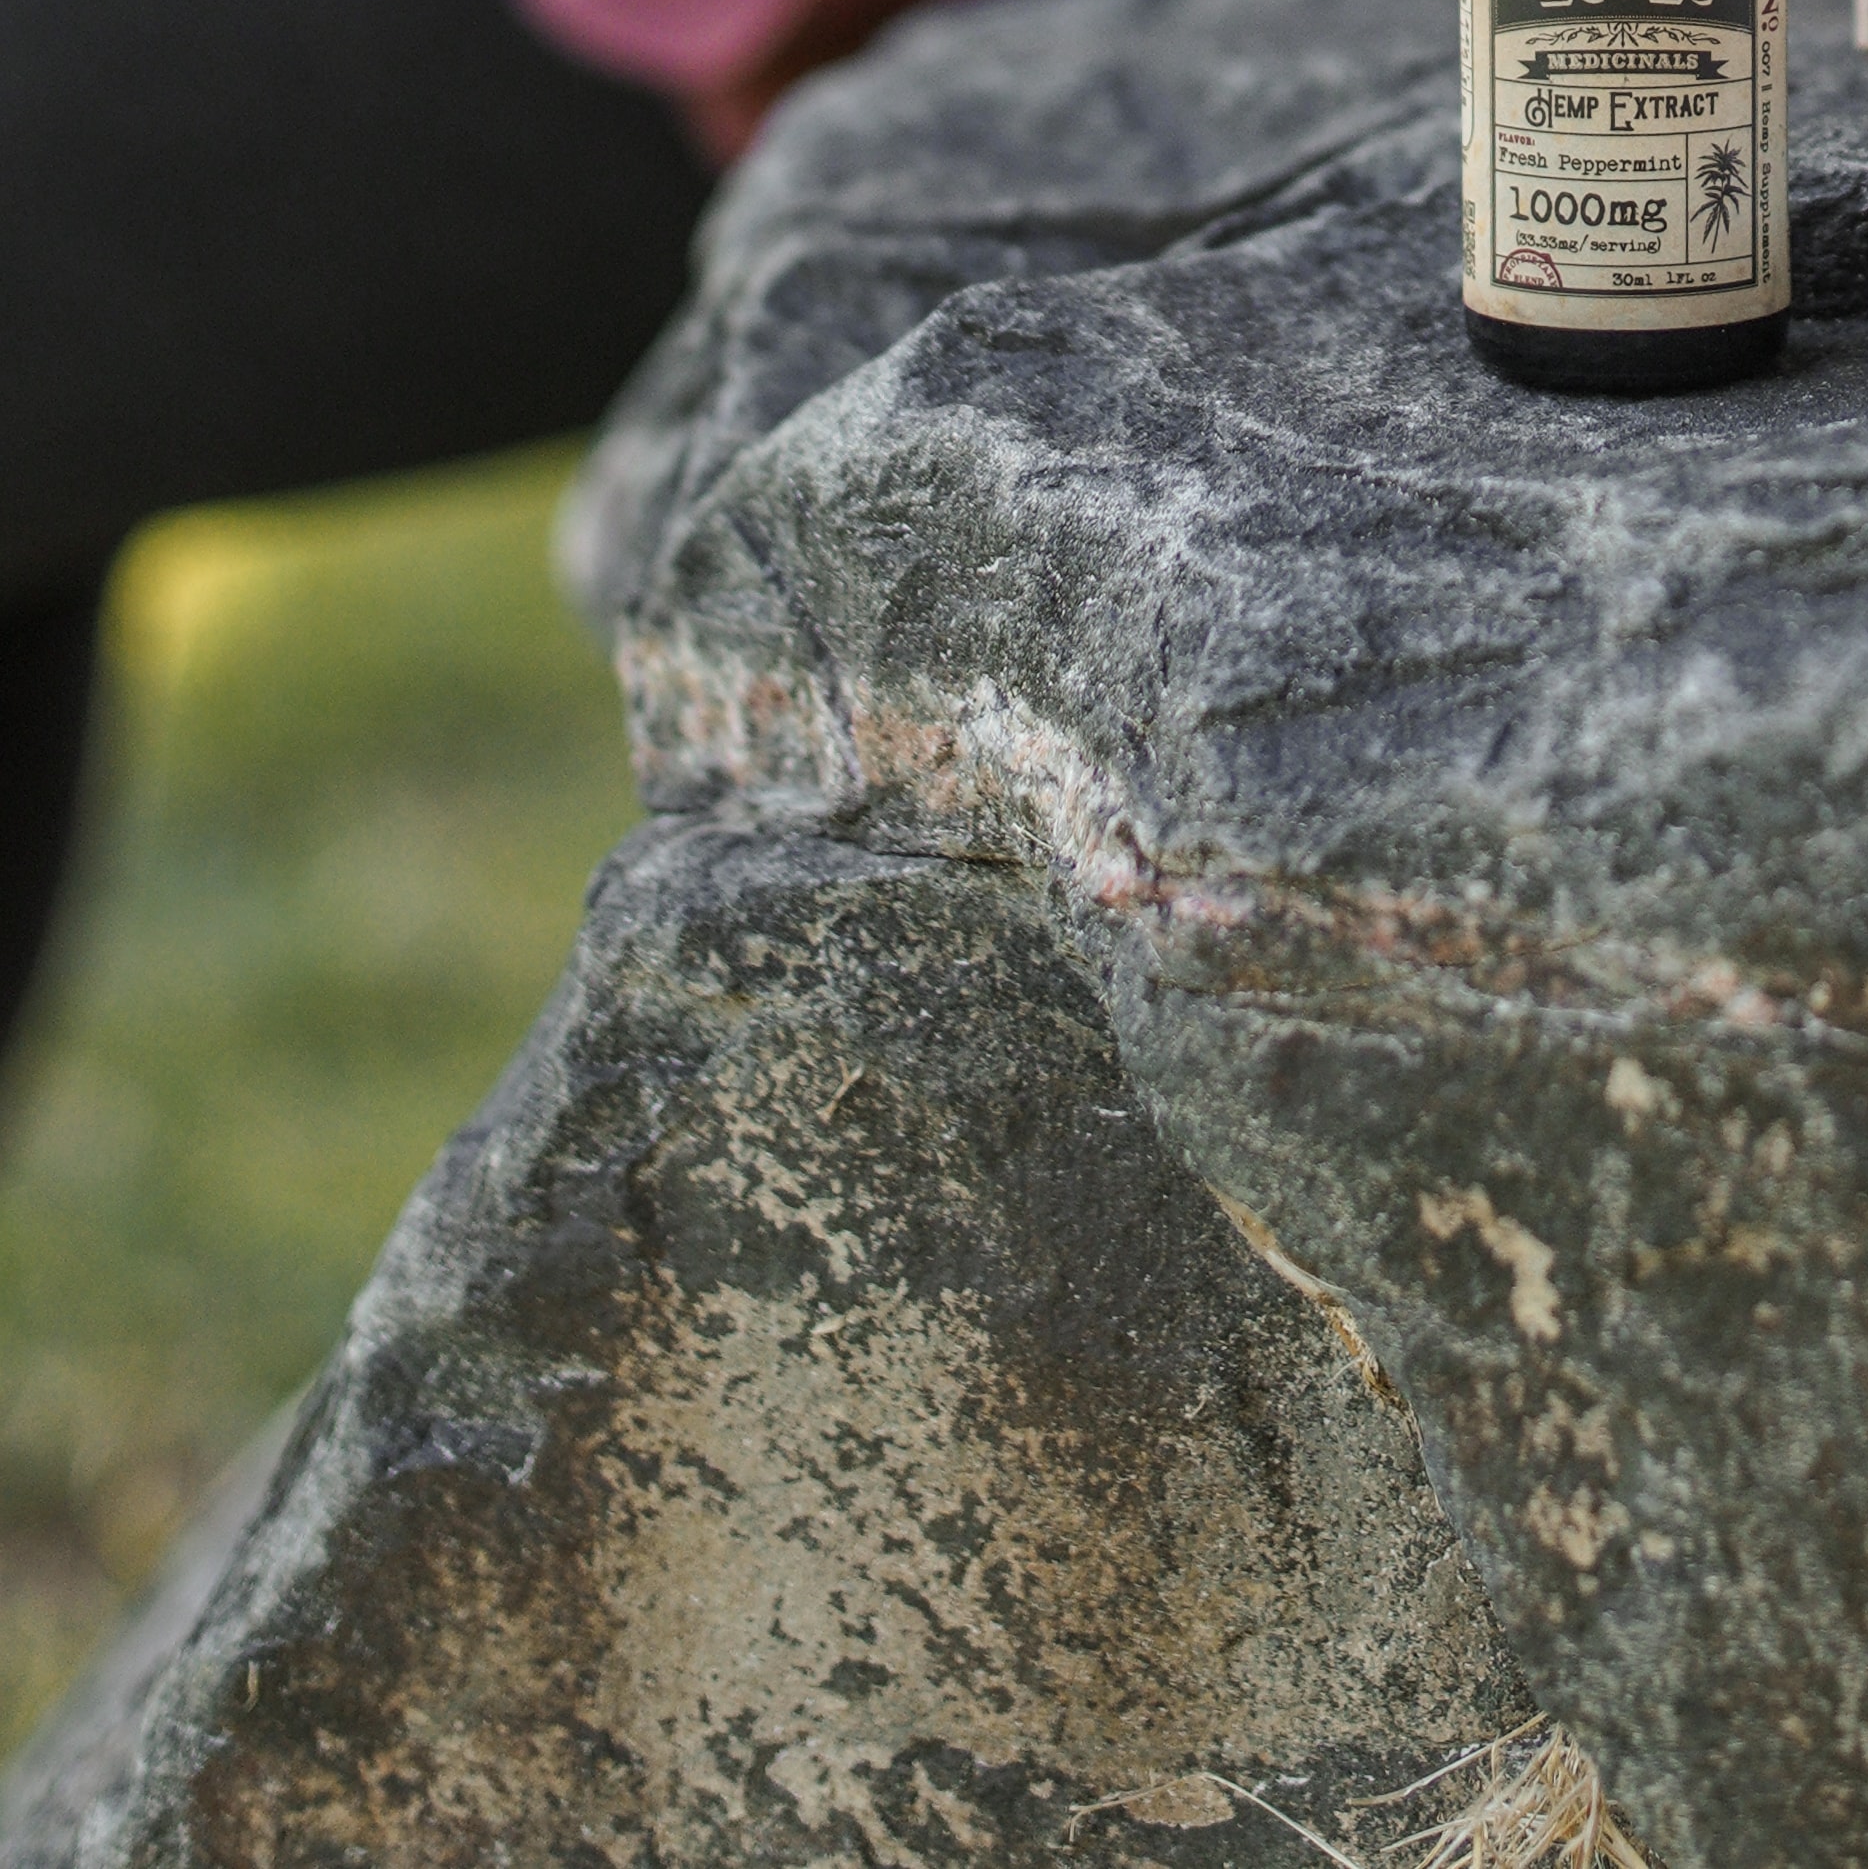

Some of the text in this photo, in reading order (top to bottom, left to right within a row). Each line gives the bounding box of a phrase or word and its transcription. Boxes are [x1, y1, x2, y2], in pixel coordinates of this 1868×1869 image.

[1546, 52, 1700, 71] MEDICINALS
[1761, 41, 1771, 77] 007
[1609, 91, 1720, 132] EXTRACT
[1759, 101, 1772, 153] Hemp
[1499, 146, 1683, 176] Fresh Peppermint
[1508, 185, 1669, 233] 1000mg
[1759, 162, 1772, 284] Supplement
[1612, 272, 1653, 286] 30ml
